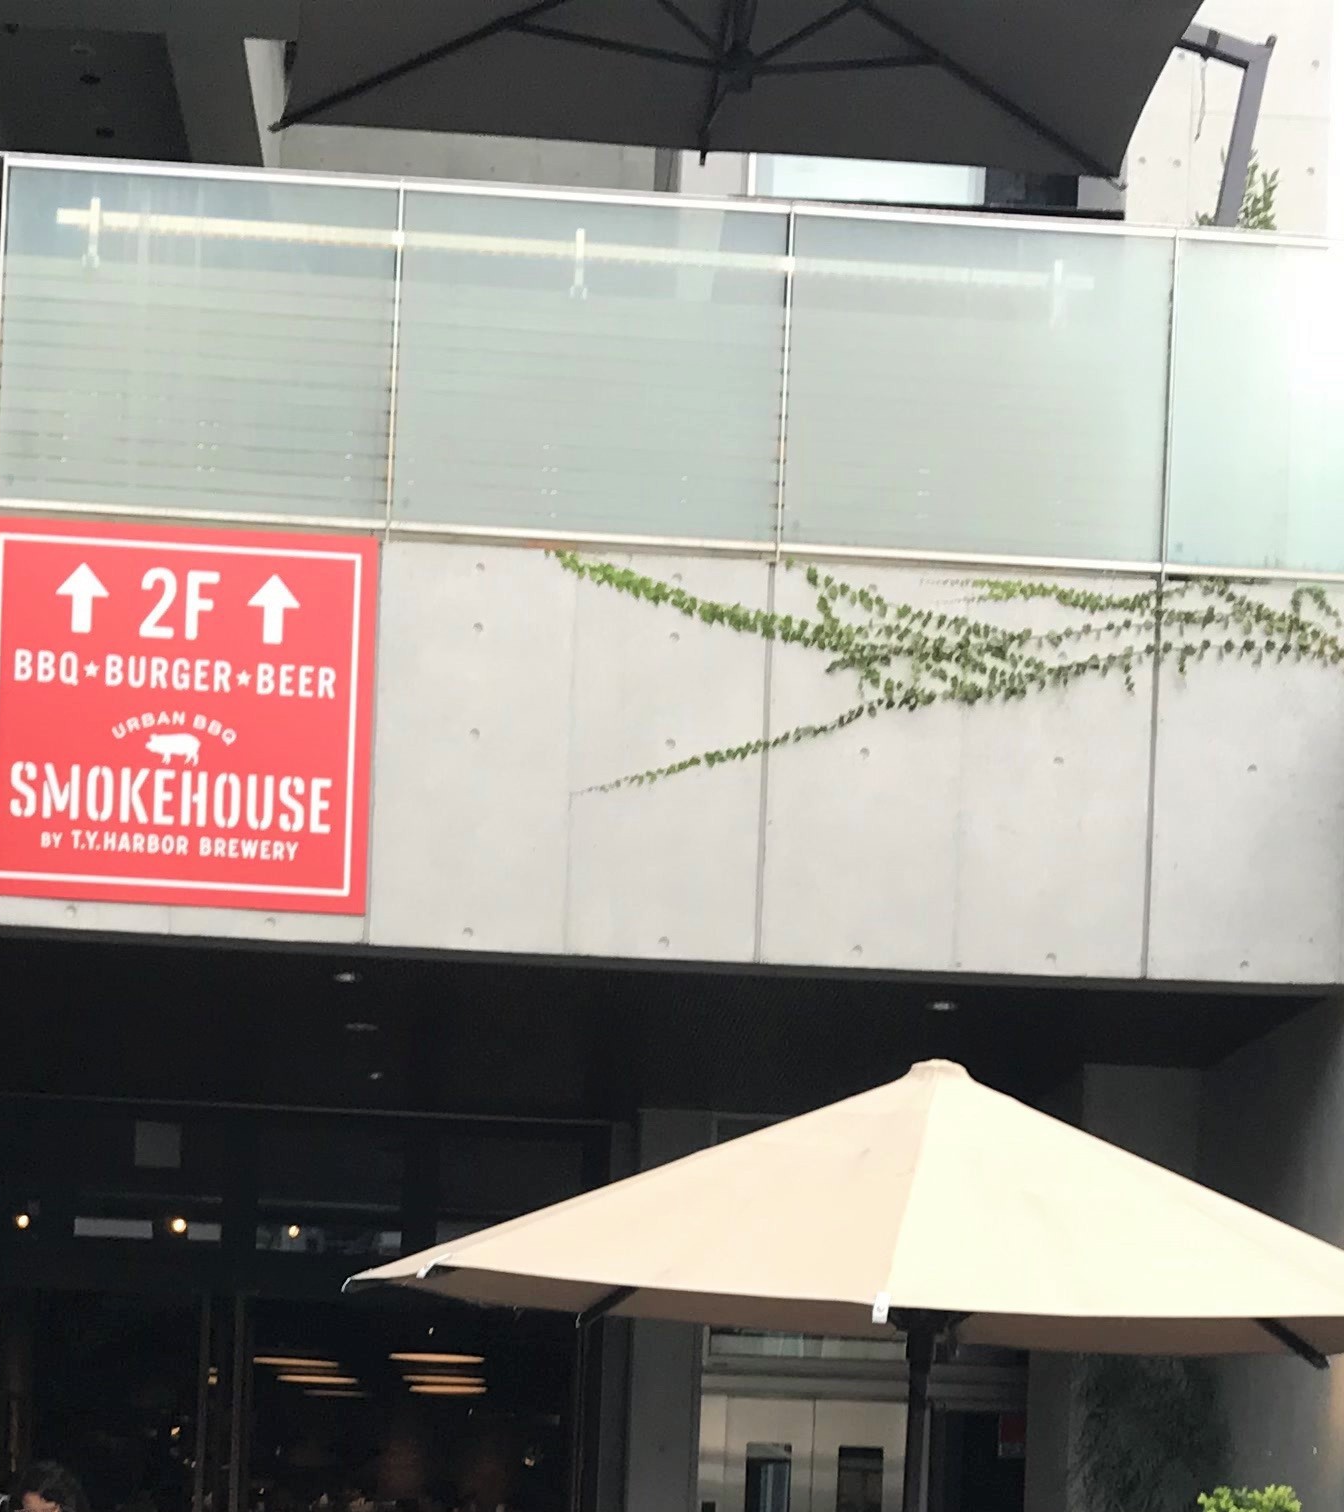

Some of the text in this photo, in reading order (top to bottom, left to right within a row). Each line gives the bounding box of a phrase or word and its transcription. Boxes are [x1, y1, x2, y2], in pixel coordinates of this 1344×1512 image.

[139, 566, 220, 641] 2F
[14, 648, 337, 700] BBQ BURGER BEER
[111, 710, 238, 746] URBAN BBQ
[9, 760, 333, 835] SMOKEHOUSE
[40, 831, 63, 850] BY
[199, 838, 299, 862] BREWERY
